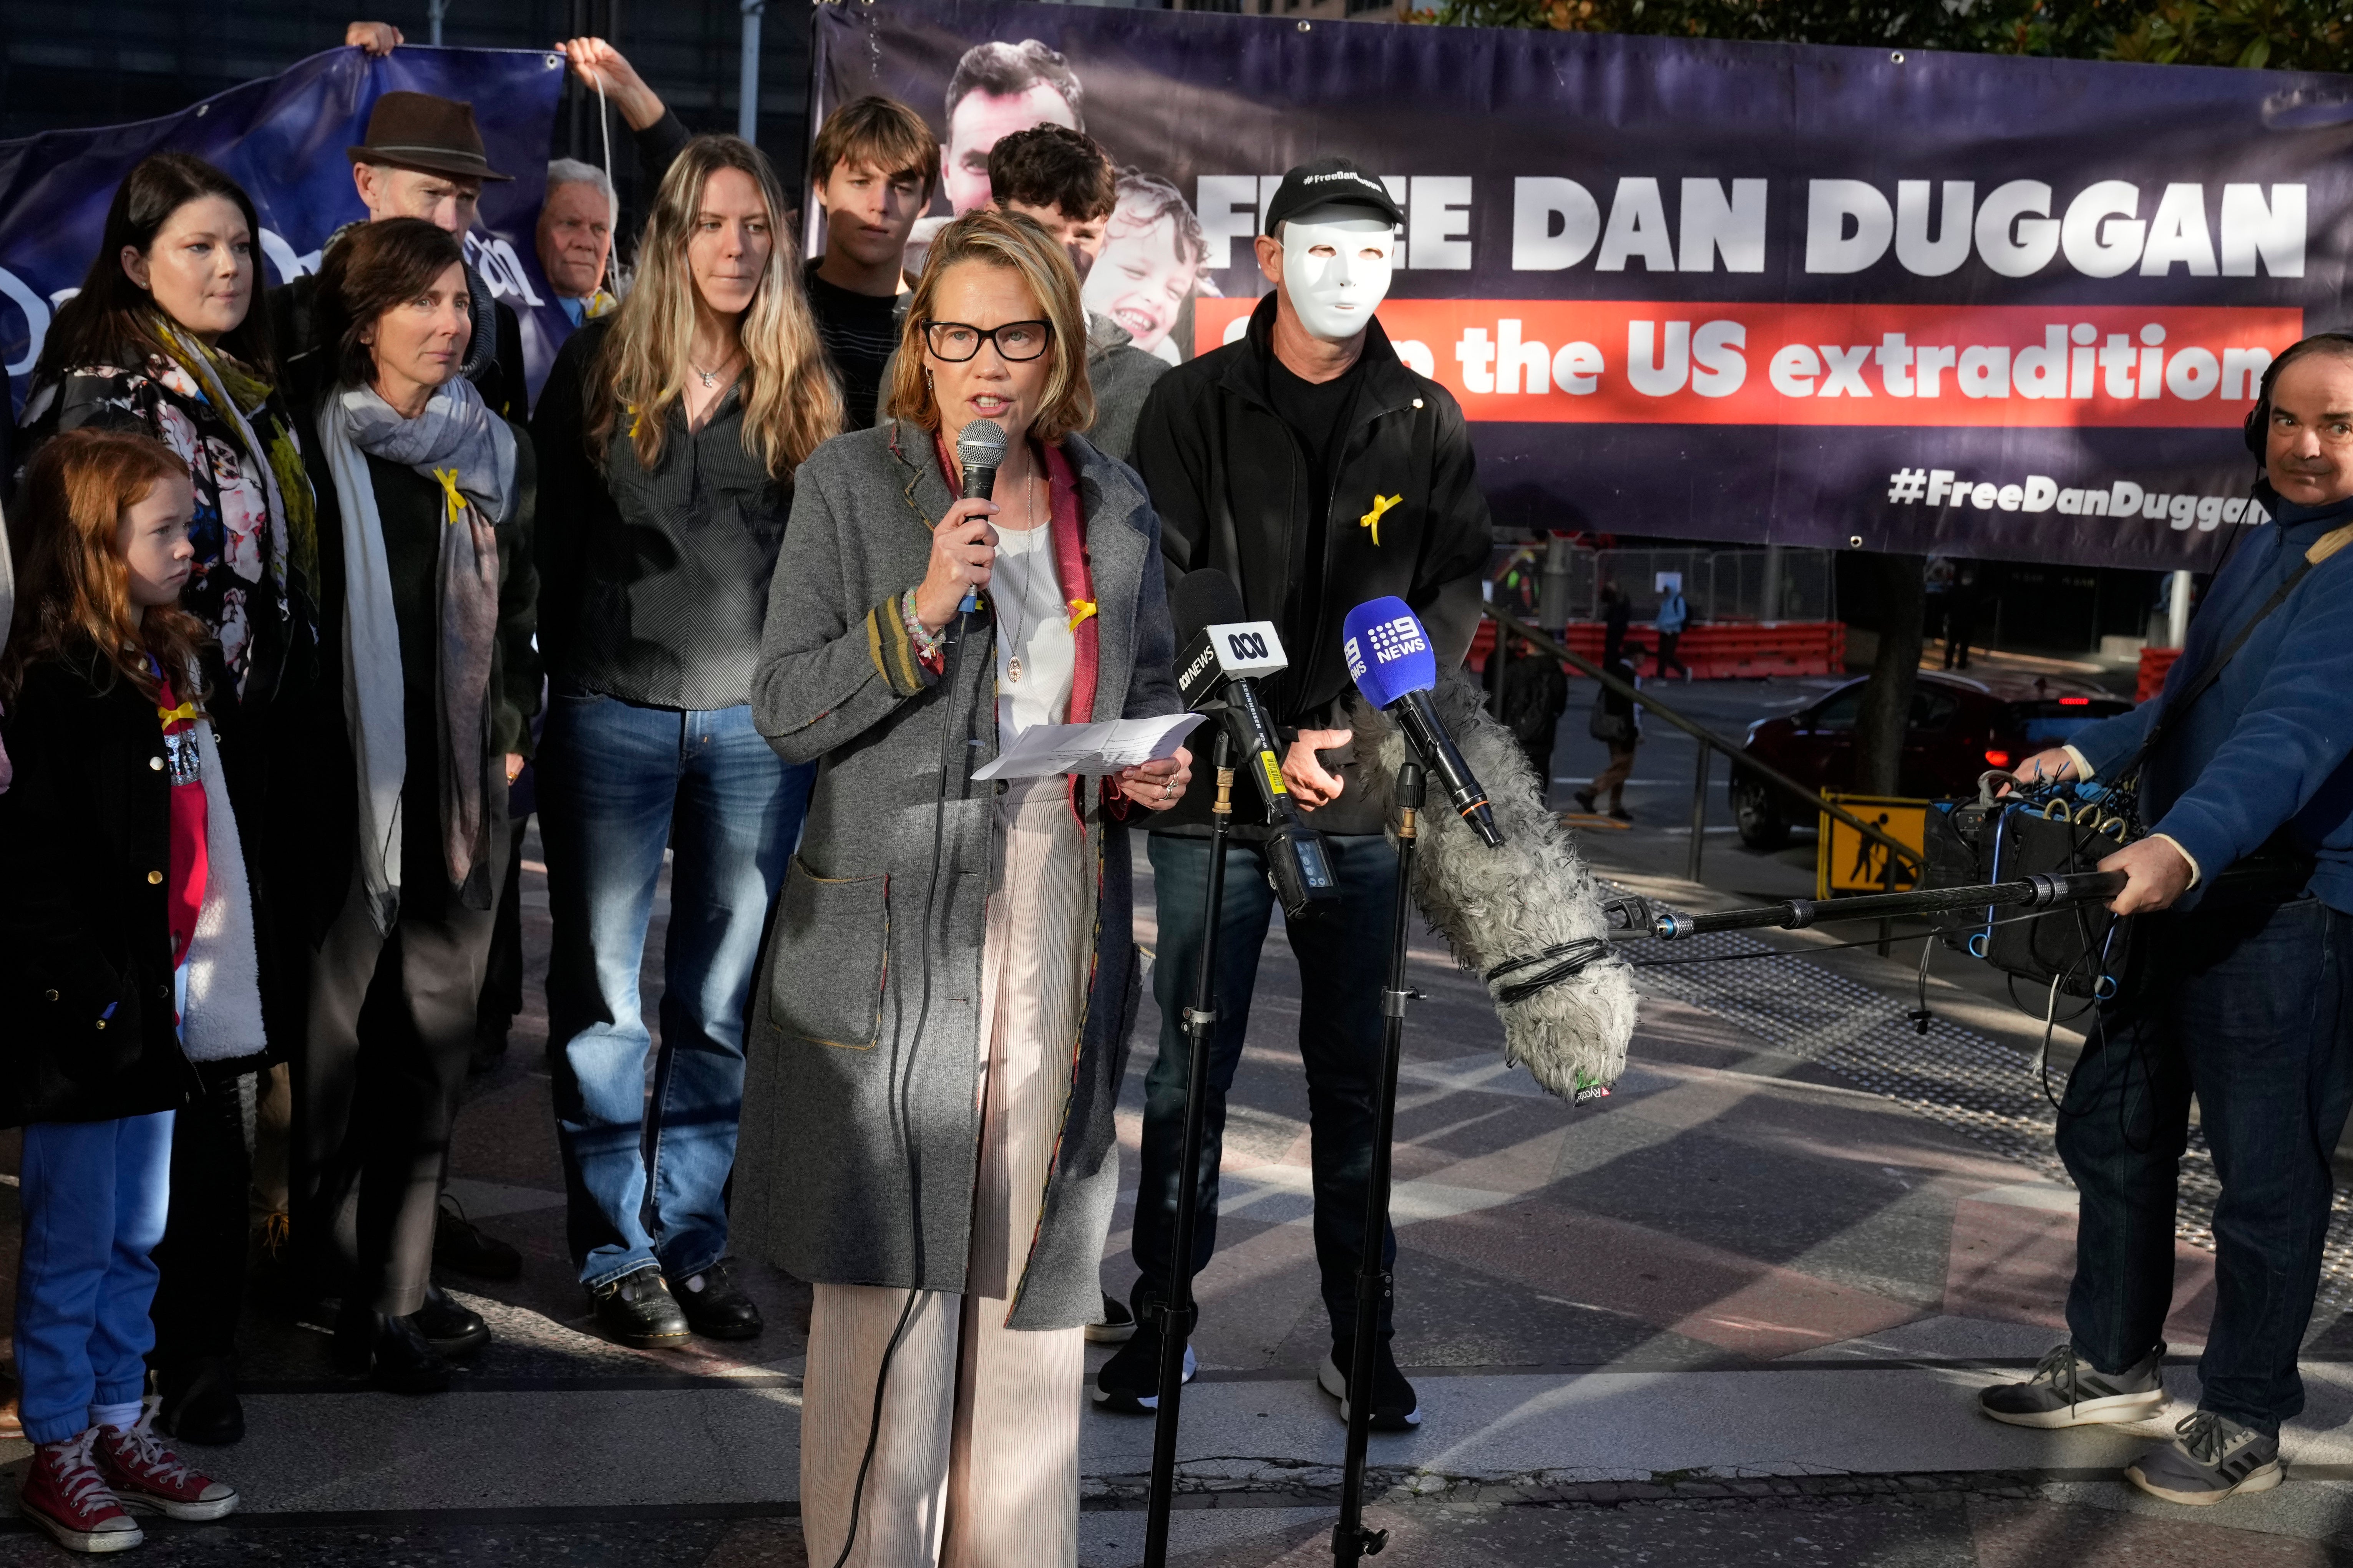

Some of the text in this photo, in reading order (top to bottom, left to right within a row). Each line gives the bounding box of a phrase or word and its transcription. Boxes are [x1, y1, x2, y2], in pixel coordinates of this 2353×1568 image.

[1303, 171, 1382, 193] #FreeDan
[1197, 175, 2307, 278] FE DAN DUGGAN
[1455, 318, 1605, 395] the
[1627, 320, 1747, 398] US
[1769, 323, 2274, 401] extradition
[1187, 645, 1214, 681] NEWS
[1376, 638, 1425, 664] NEWS
[1241, 683, 1261, 729] SENNHEISER
[1259, 733, 1265, 741] MD
